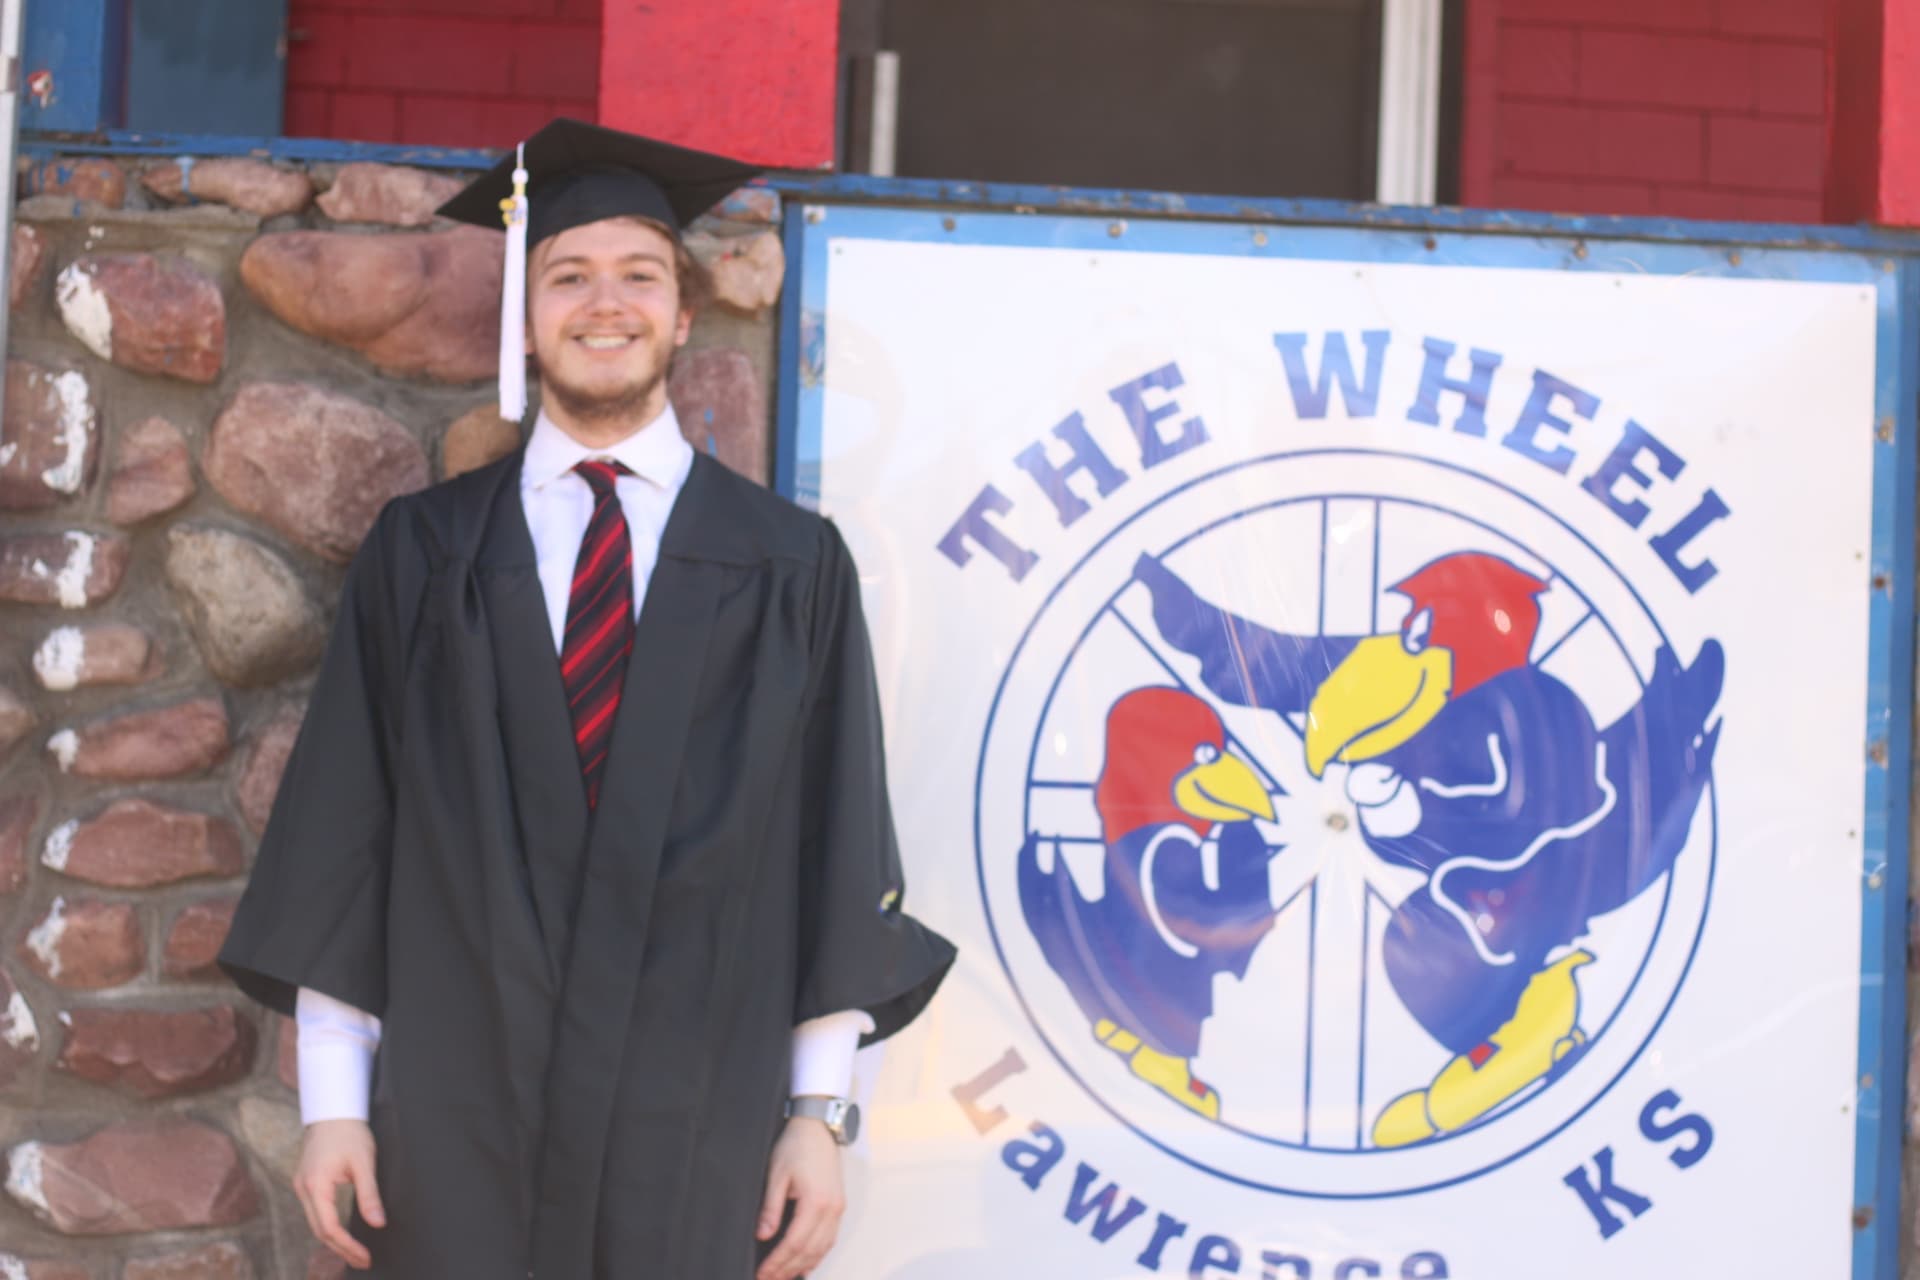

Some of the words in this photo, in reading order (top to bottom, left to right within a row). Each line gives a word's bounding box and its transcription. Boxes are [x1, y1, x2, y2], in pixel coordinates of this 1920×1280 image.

[936, 361, 1211, 584] THE
[1273, 329, 1732, 596] WHEEL
[1563, 1089, 1715, 1239] KS
